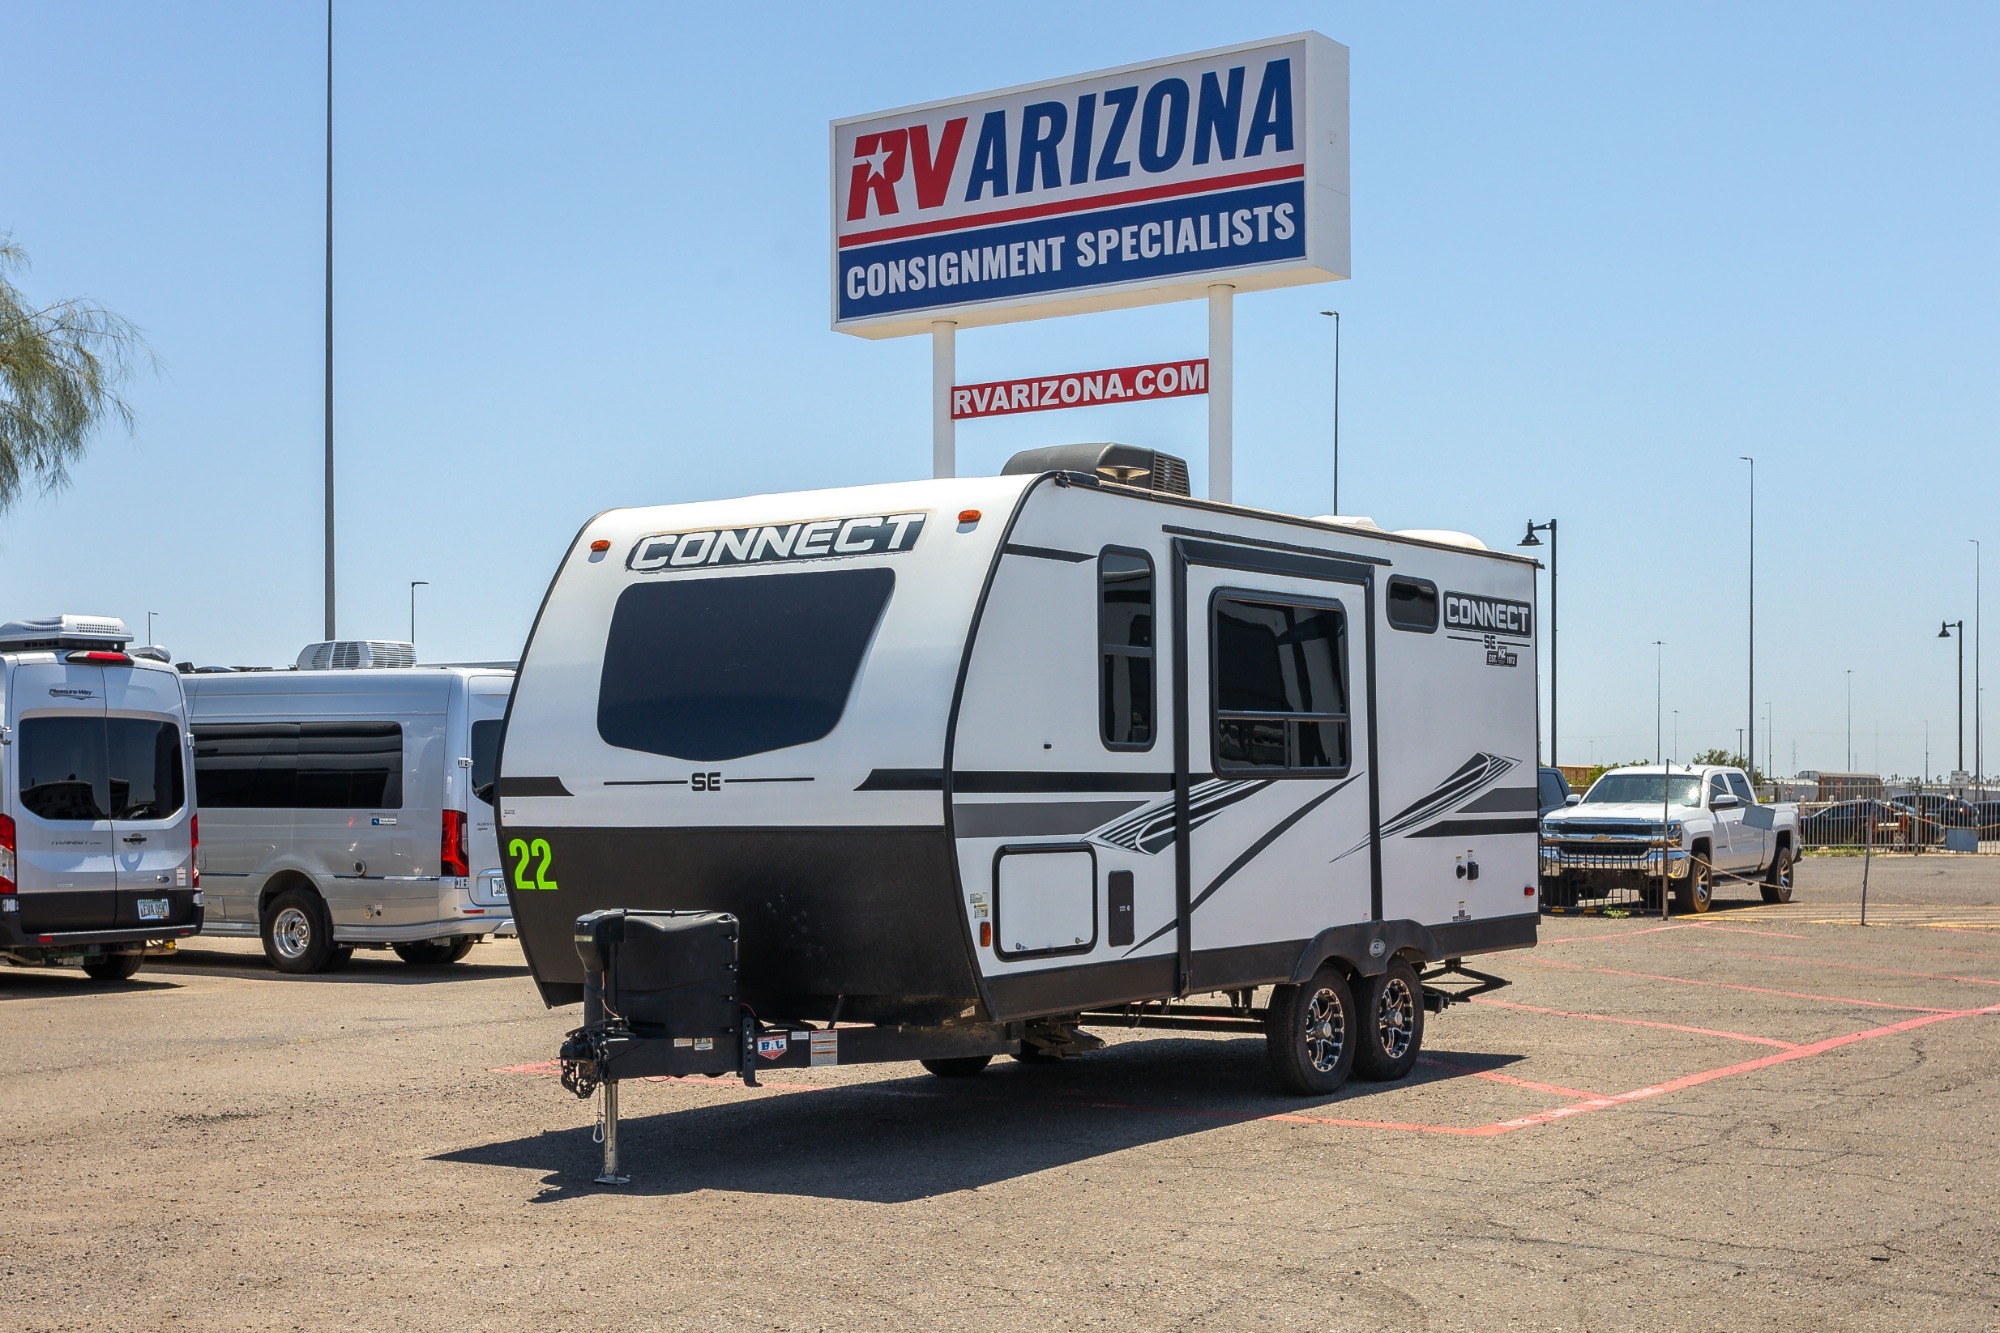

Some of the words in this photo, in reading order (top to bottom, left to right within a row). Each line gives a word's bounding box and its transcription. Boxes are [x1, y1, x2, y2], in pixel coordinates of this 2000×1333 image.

[846, 235, 1066, 300] CONSIGNMENT
[1076, 202, 1296, 258] SPECIALISTS
[953, 363, 1206, 415] RVARIZONA.COM
[629, 513, 925, 570] CONNECT
[1446, 596, 1529, 632] CONNECT
[1484, 634, 1496, 649] SE
[691, 771, 721, 791] SE
[508, 838, 559, 890] 22
